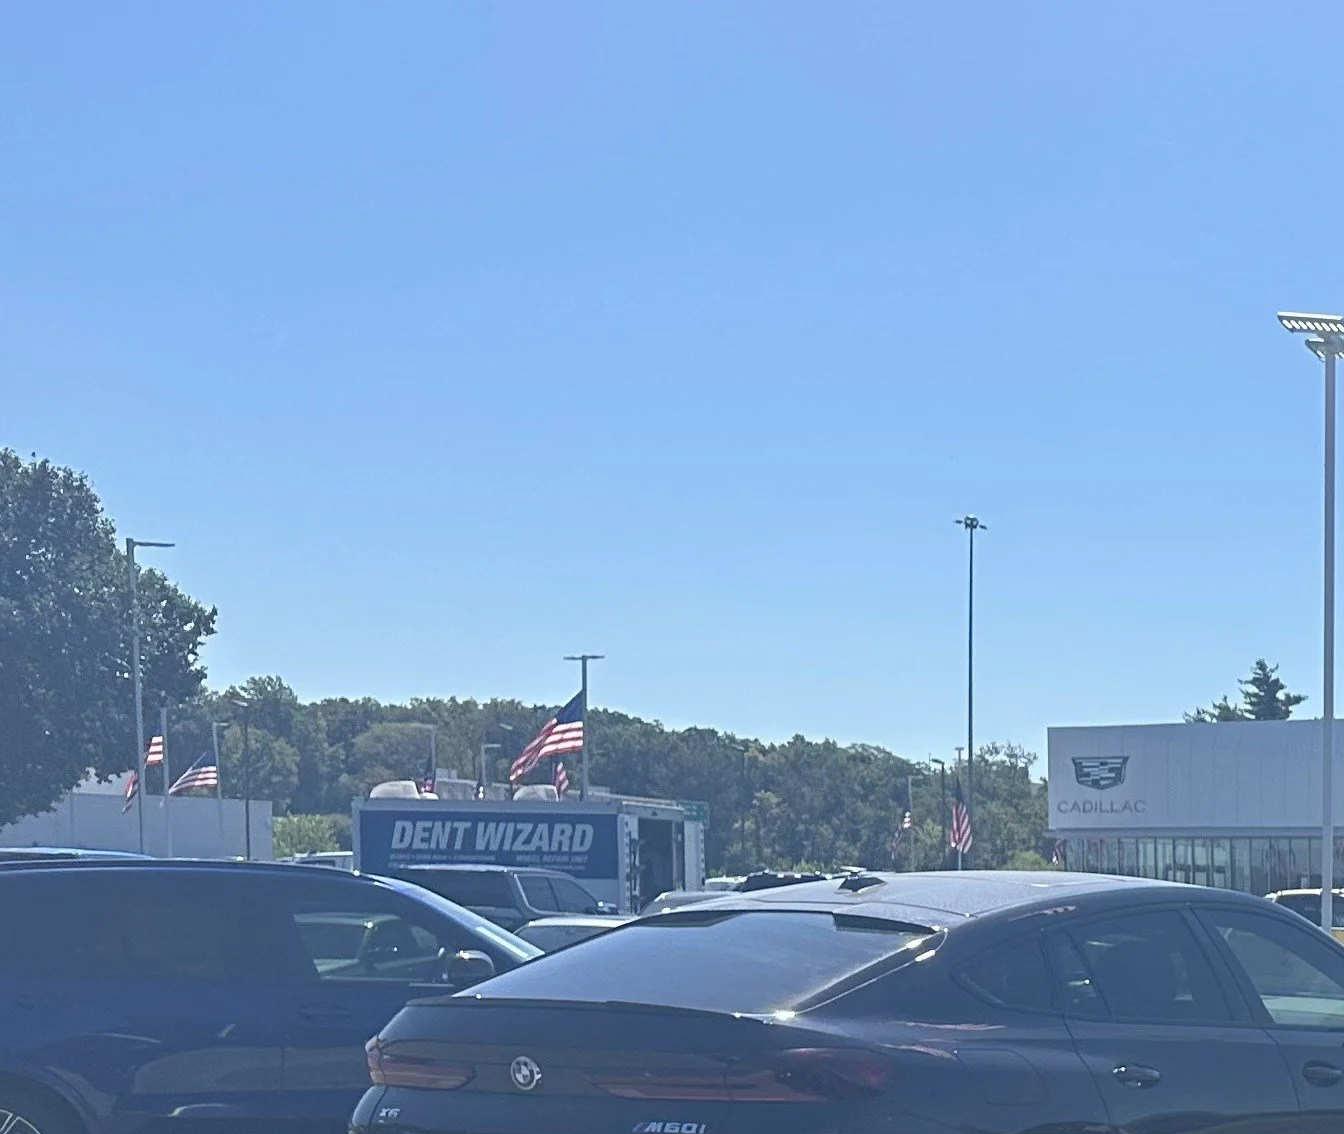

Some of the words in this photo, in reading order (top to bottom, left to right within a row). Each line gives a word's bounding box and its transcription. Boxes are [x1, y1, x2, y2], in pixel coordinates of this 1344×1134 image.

[1057, 800, 1147, 813] CADILLAC
[391, 819, 472, 850] DENT
[475, 821, 595, 853] WIZARD
